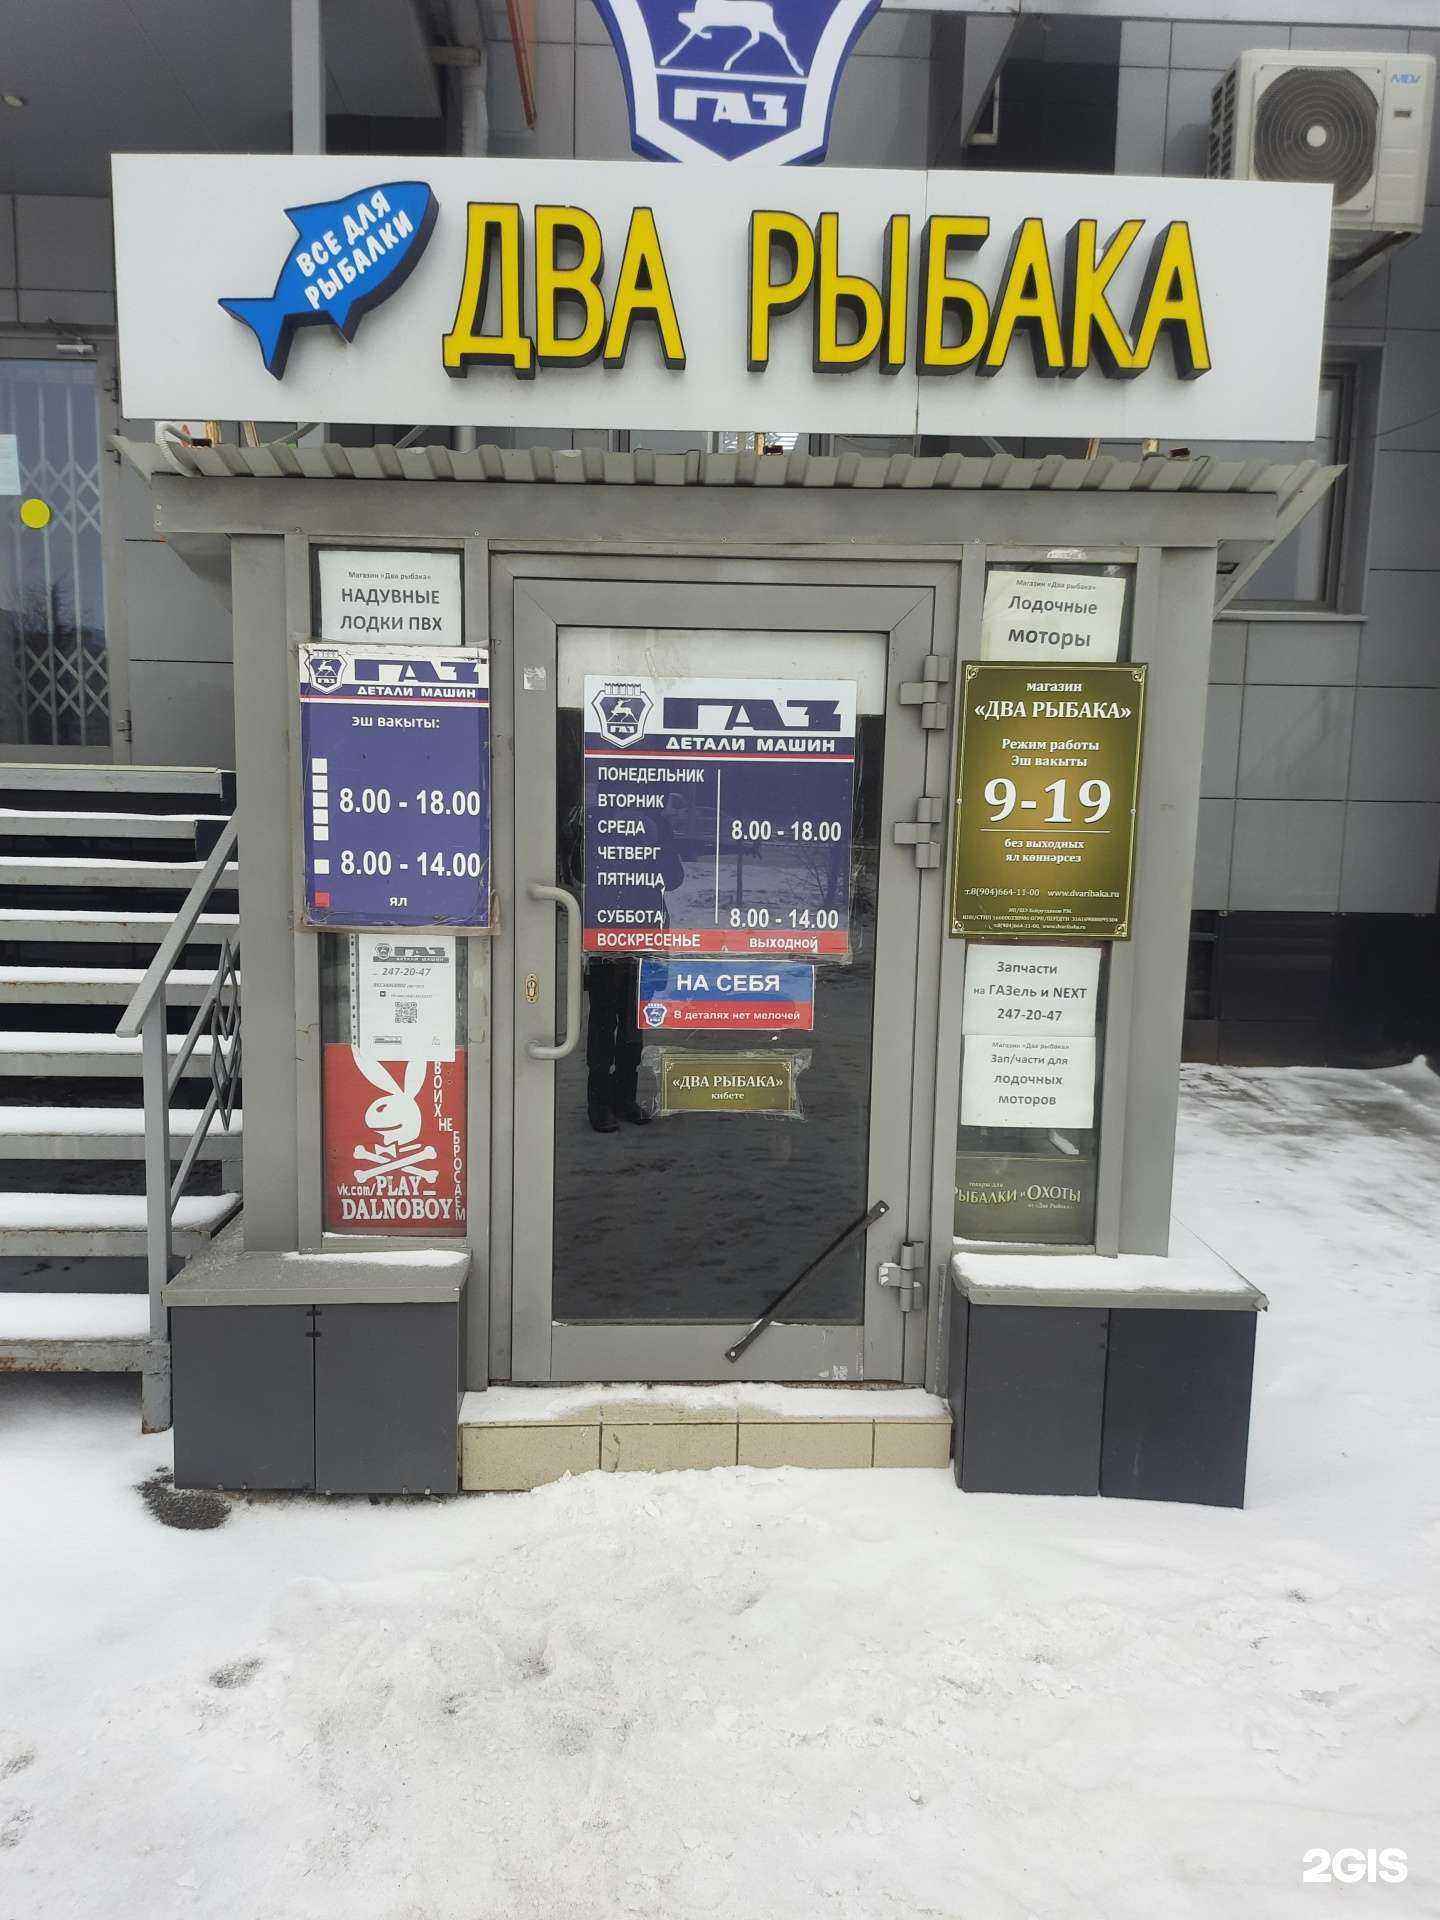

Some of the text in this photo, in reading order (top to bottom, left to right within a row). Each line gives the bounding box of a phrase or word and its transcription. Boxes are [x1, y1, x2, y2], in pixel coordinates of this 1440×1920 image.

[674, 88, 787, 126] ГАЗ
[296, 190, 391, 277] ВСЕ ДЛЯ
[305, 210, 414, 310] РЫБАЛКИ
[442, 201, 1212, 381] ДВА РЫБАКА
[341, 588, 440, 606] НАДУВНЫЕ
[1008, 596, 1098, 615] Лодочные
[340, 615, 442, 633] ЛОДКИ ПВХ
[1008, 629, 1091, 649] моторы
[354, 659, 480, 684] ГАЗ
[357, 686, 476, 698] ДЕТАЛИ МАШИН
[1026, 682, 1082, 692] магазин
[663, 698, 841, 732] ГАЗ
[974, 701, 1132, 720] «ДВА РЫБАКА»
[377, 716, 440, 729] вакыты:
[665, 737, 835, 752] ДЕТАЛИ МАШИН
[1002, 738, 1099, 751] Режим работы
[1011, 755, 1087, 767] Эш вакыты
[598, 767, 705, 784] ПОНЕДЕЛЬНИК
[339, 788, 391, 813] 8.00
[416, 790, 481, 816] 18.00
[598, 794, 665, 808] ВТОРНИК
[984, 778, 1111, 823] 9-19
[597, 820, 646, 835] СРЕДА
[731, 820, 771, 840] 8.00
[791, 821, 842, 841] 18.00
[1004, 838, 1085, 850] без выходных
[597, 847, 661, 860] ЧЕТВЕРГ
[1005, 854, 1021, 862] ял
[340, 850, 392, 875] 8.00
[416, 852, 481, 877] 14.00
[597, 873, 665, 889] ПЯТНИЦА
[1047, 889, 1120, 898] www.dvaribaka.ru
[389, 897, 408, 907] ял
[597, 910, 664, 924] СУББОТА
[730, 908, 769, 928] 8.00
[788, 909, 839, 929] 14.00
[597, 933, 701, 947] ВОСКРЕСЕНЬЕ
[382, 967, 432, 977] 247-20-47
[997, 961, 1058, 975] Запчасти
[676, 974, 780, 992] НА СЕБЯ
[974, 984, 1088, 999] на ГАЗель и NEXT
[685, 1011, 729, 1020] деталях
[733, 1011, 751, 1020] нет
[754, 1010, 800, 1021] мелочей
[997, 1008, 1063, 1022] 247-20-47
[991, 1054, 1068, 1066] Зап/части для
[672, 1075, 783, 1090] «ДВА РЫБАКА»
[994, 1076, 1063, 1086] лодочных
[711, 1091, 745, 1100] кибете
[998, 1095, 1057, 1107] моторов
[439, 1117, 453, 1132] НЕ
[453, 1130, 466, 1221] БРОСАЕМ
[1027, 1184, 1081, 1203] ОХОТЫ
[341, 1199, 453, 1220] DALNOBOY
